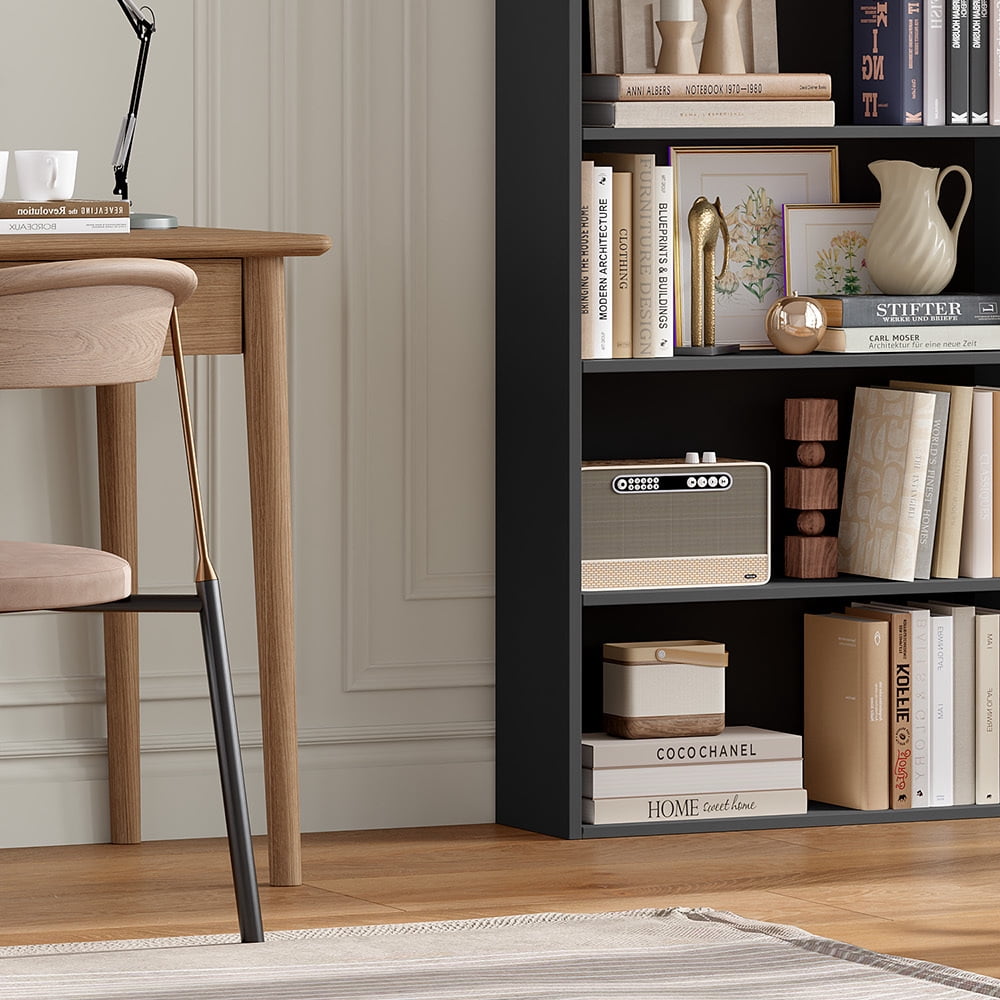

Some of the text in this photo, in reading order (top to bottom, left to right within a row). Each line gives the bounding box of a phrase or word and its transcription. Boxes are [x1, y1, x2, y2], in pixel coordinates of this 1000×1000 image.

[626, 84, 724, 96] ANNI ALBERS NOTEBOOK
[581, 205, 589, 227] HOME
[581, 230, 589, 256] HOUSE
[659, 203, 667, 263] BLUEPRINTS
[581, 258, 589, 273] THE
[599, 198, 608, 320] MODERN ARCHITECTURE
[619, 228, 628, 289] CLOTHING
[640, 157, 652, 354] FURNITURE DESIGN
[659, 276, 667, 329] BUILDINGS
[876, 302, 962, 317] STIFTER
[883, 315, 910, 323] WERKE
[930, 314, 958, 322] BRIEFE
[868, 341, 909, 349] Architektur
[912, 340, 923, 349] für
[963, 339, 977, 347] Zeit
[869, 334, 888, 342] CARL
[920, 419, 941, 545] WORLD'S FINEST HOMES
[648, 794, 757, 819] HOME sweet home
